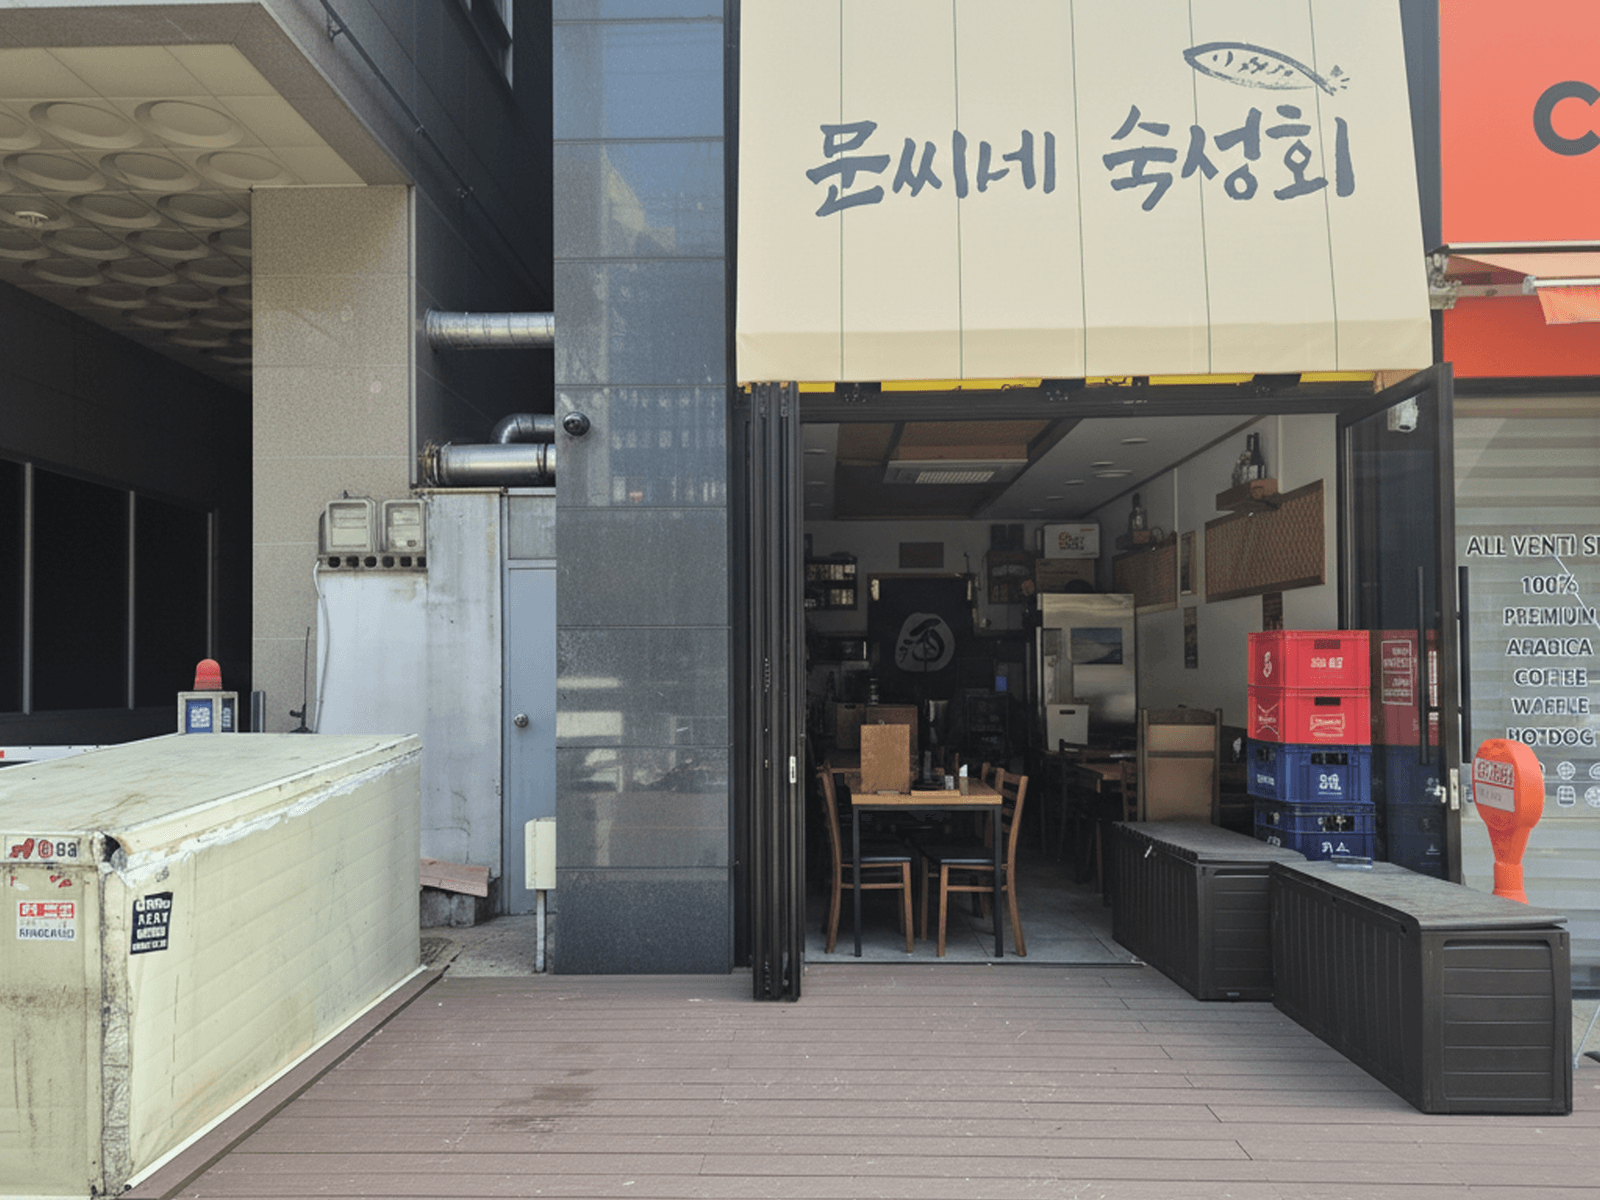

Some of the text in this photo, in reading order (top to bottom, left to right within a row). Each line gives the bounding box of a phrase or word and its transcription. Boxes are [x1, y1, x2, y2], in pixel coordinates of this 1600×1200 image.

[1532, 80, 1600, 156] C
[806, 104, 1355, 217] 문씨네 숙성회
[1466, 535, 1507, 557] ALL
[1511, 534, 1577, 557] VENTI
[1521, 574, 1579, 595] 100%
[1505, 638, 1594, 656] ARABICA
[1513, 667, 1588, 687] COFFEE
[1511, 697, 1590, 715] WAFFLE
